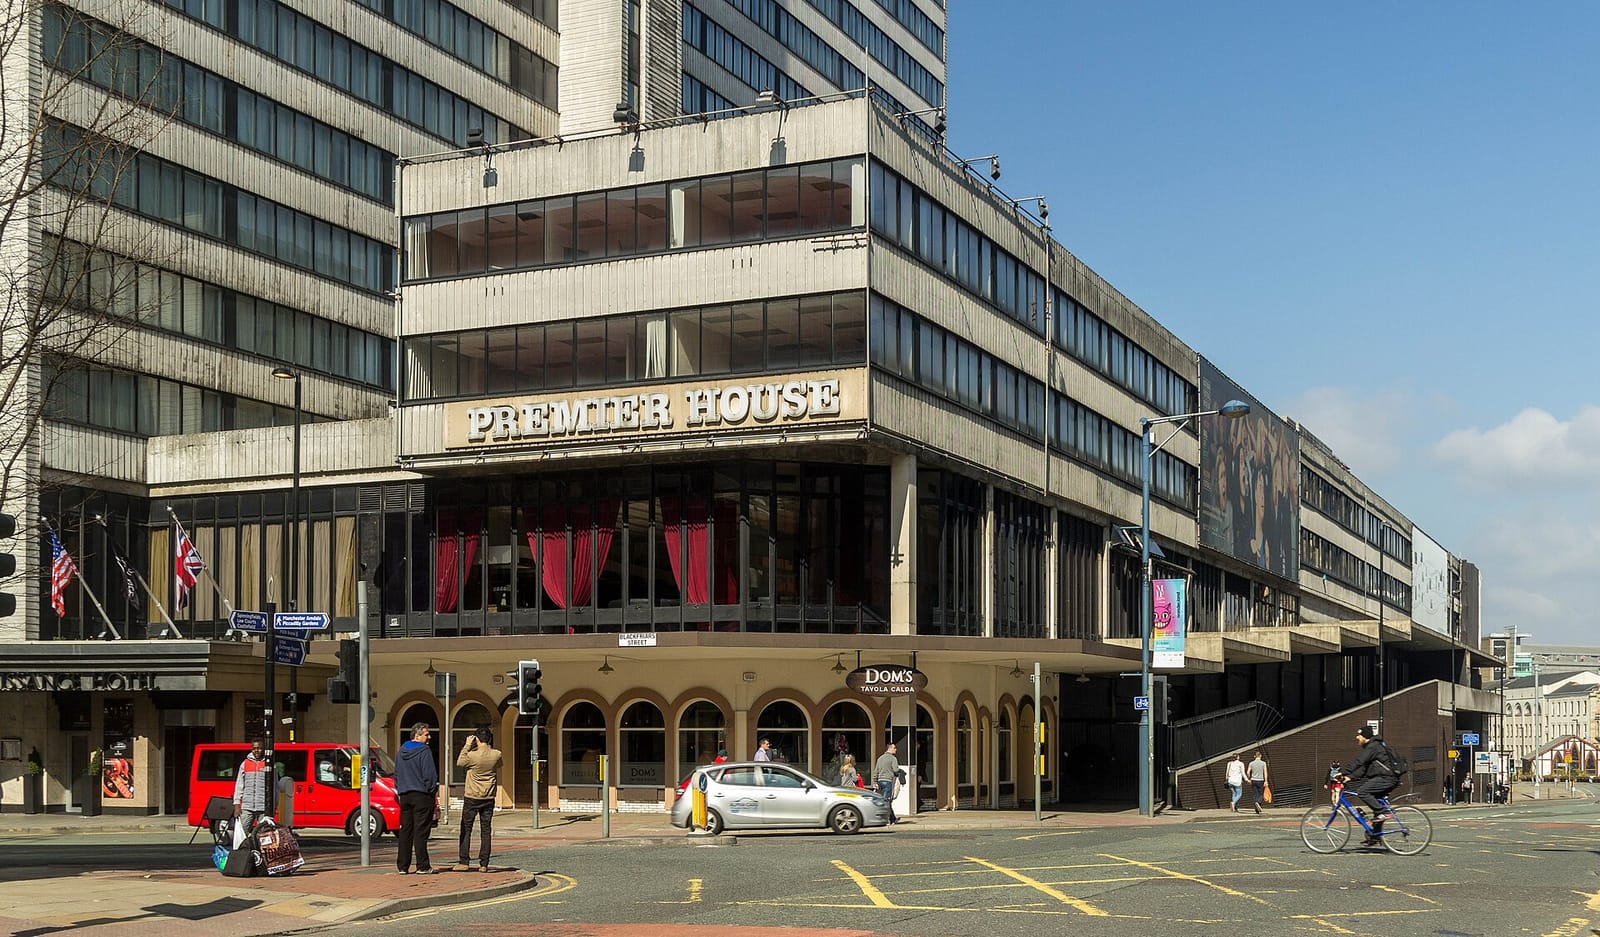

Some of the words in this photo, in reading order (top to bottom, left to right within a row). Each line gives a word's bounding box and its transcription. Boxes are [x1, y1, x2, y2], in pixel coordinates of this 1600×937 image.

[466, 391, 674, 442] PREMIER
[686, 379, 841, 427] HOUSE
[865, 668, 913, 684] DOM'S
[631, 768, 656, 777] DOM'S
